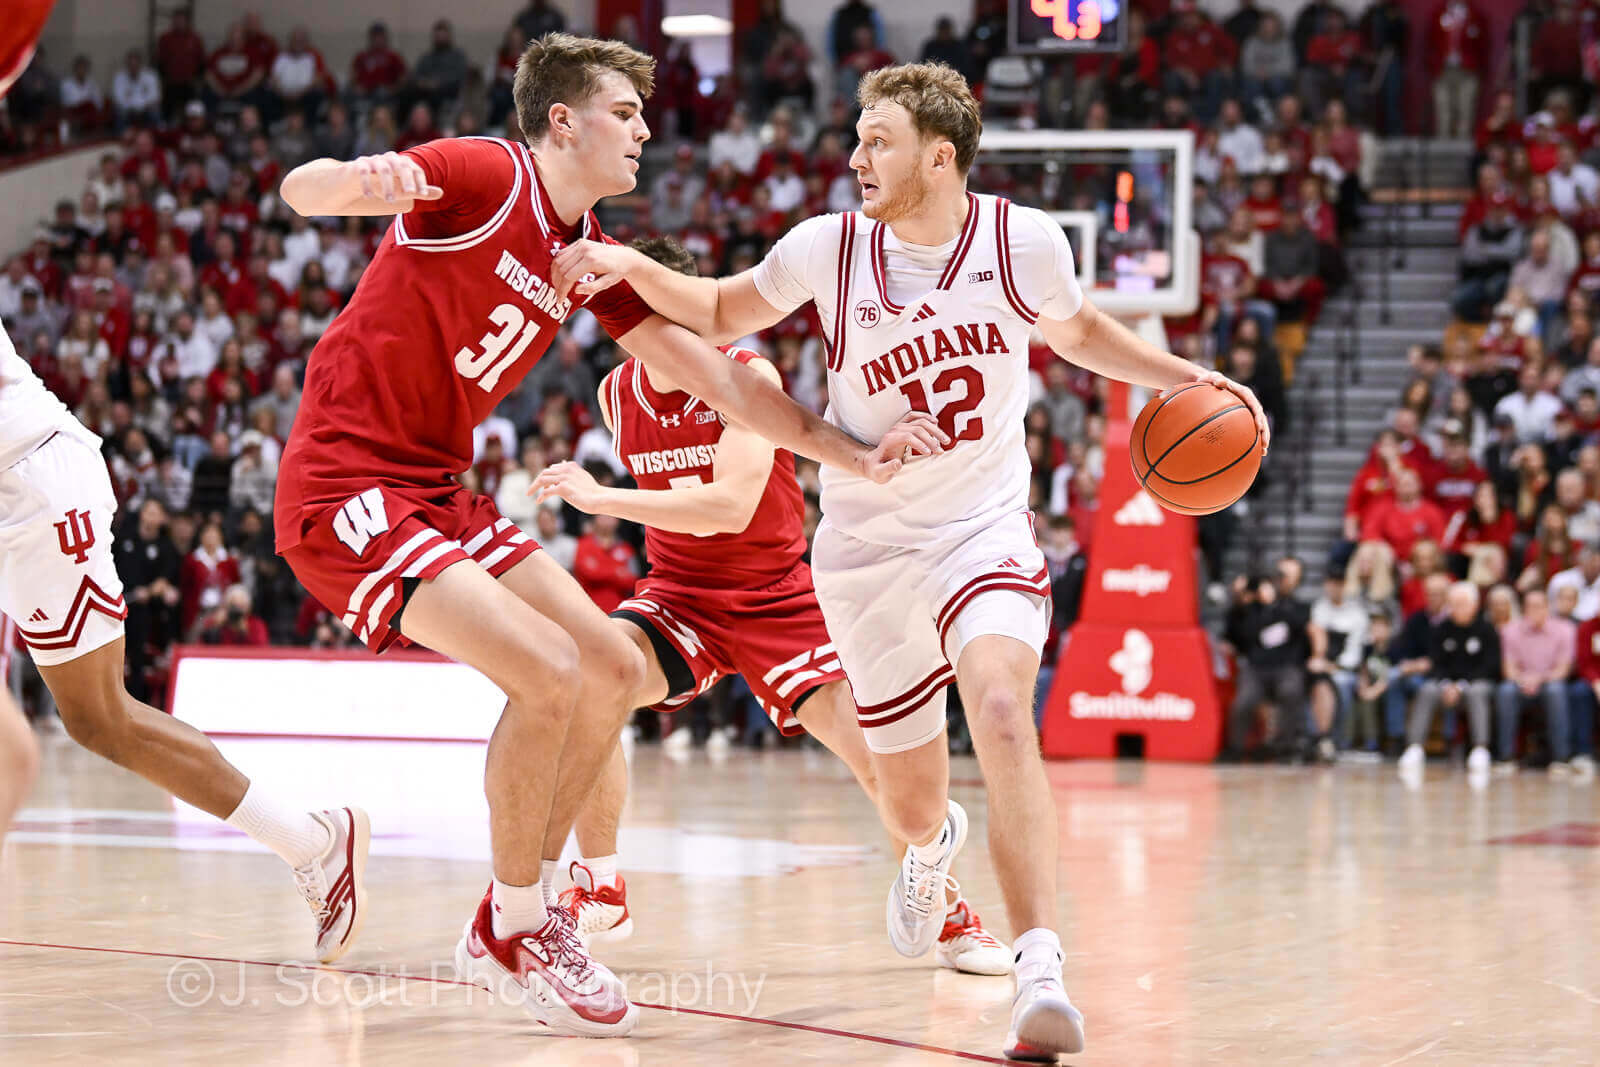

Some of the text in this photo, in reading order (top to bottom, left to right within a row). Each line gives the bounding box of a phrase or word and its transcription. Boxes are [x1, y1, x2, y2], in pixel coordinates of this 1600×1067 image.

[454, 303, 541, 393] 31
[860, 322, 1010, 397] INDIANA
[332, 487, 390, 558] W
[1069, 691, 1195, 721] Smithville
